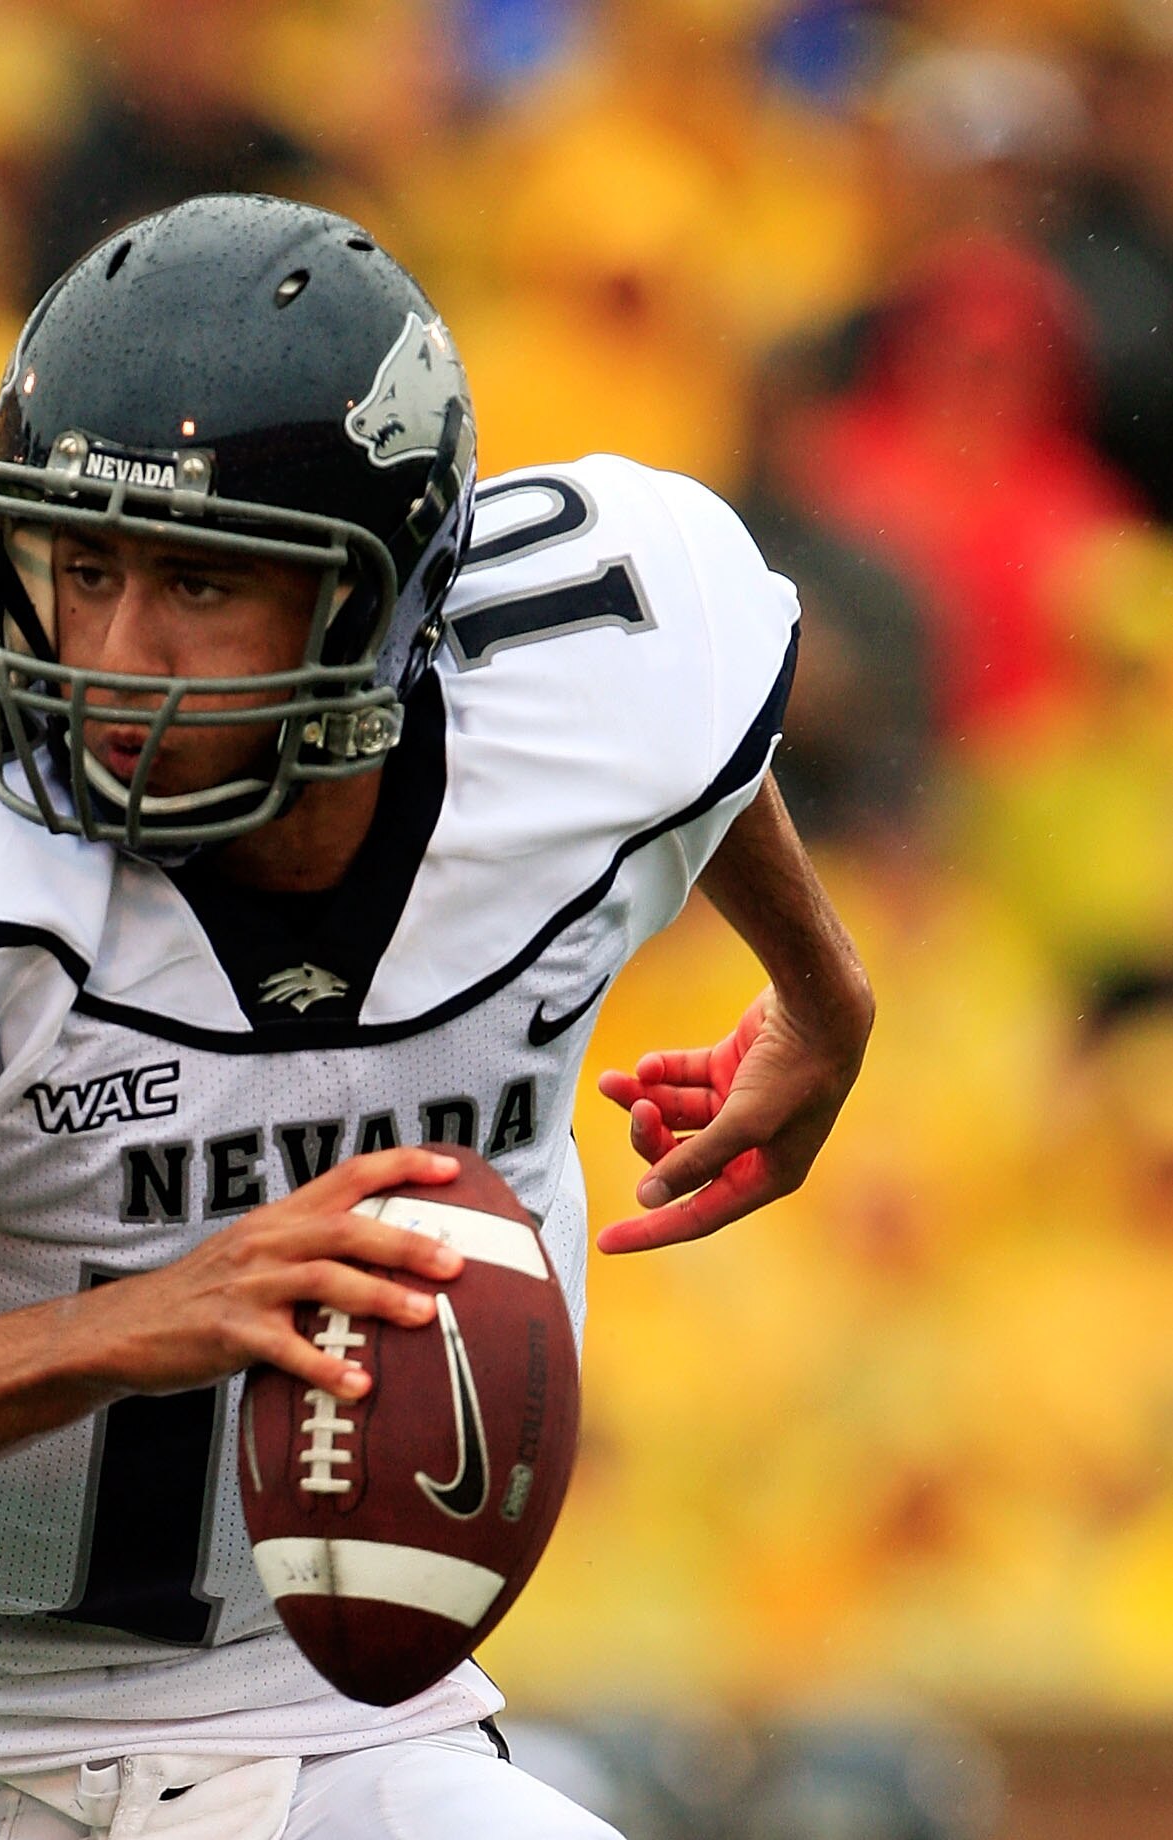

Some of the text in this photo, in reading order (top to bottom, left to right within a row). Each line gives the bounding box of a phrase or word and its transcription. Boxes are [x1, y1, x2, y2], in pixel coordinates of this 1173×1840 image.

[86, 452, 176, 488] NEVADA
[443, 473, 659, 673] 10
[26, 1061, 180, 1135] WAC
